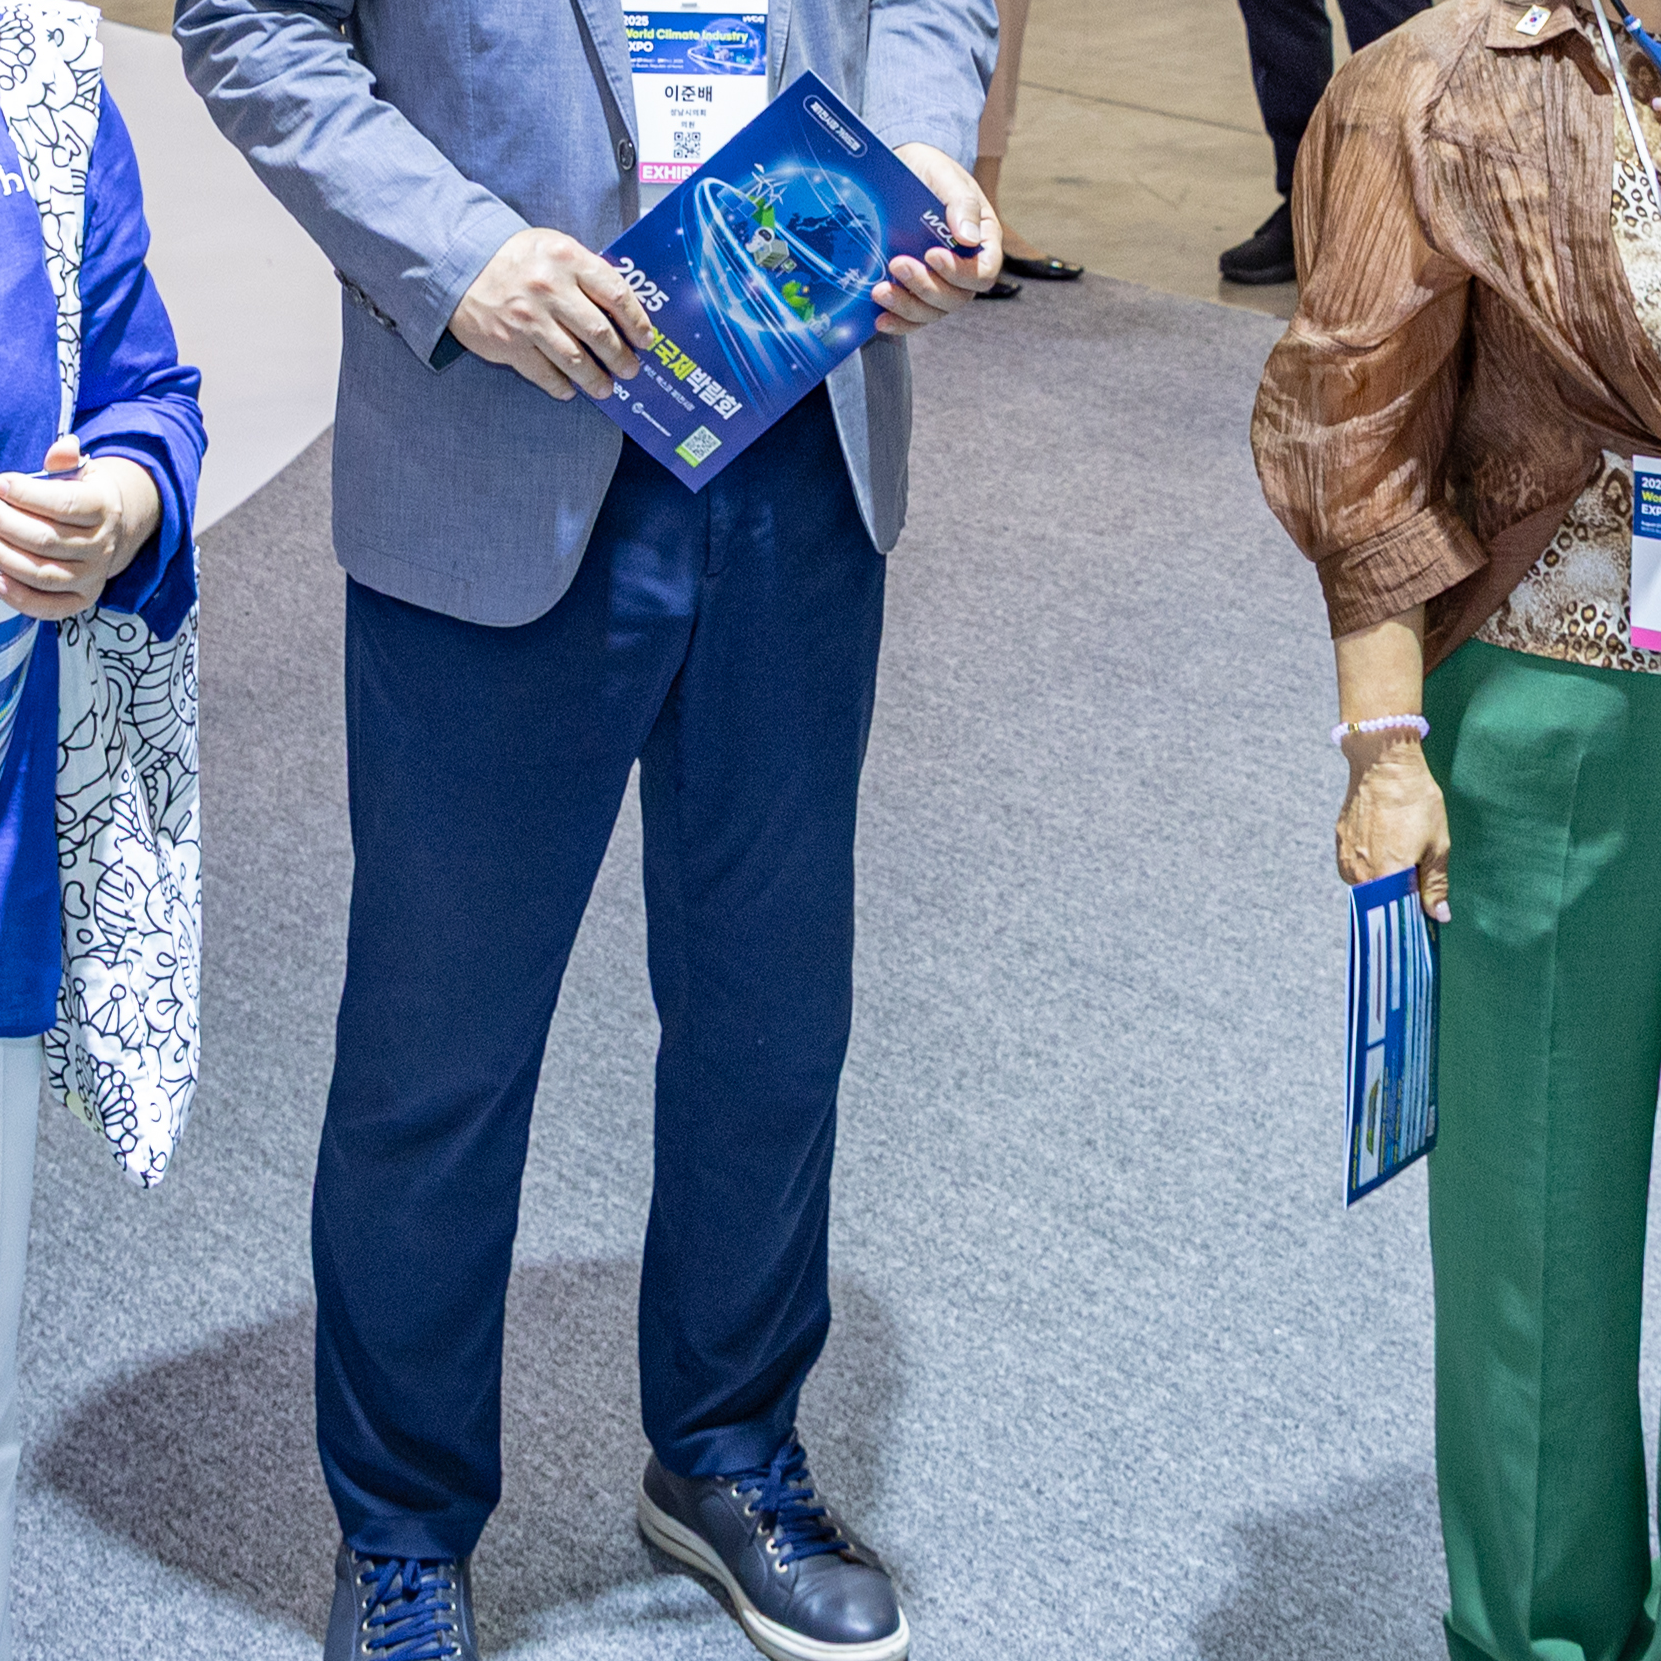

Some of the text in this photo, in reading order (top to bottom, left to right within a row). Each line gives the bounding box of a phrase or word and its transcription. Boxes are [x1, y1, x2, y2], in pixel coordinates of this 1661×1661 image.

[624, 14, 650, 27] 2025
[656, 28, 700, 41] Climate
[702, 29, 749, 43] Industry
[628, 40, 654, 53] XPO
[664, 84, 713, 103] 이준배
[641, 164, 698, 180] EXHIB
[614, 256, 670, 312] 2025
[646, 325, 743, 421] 국제박람회
